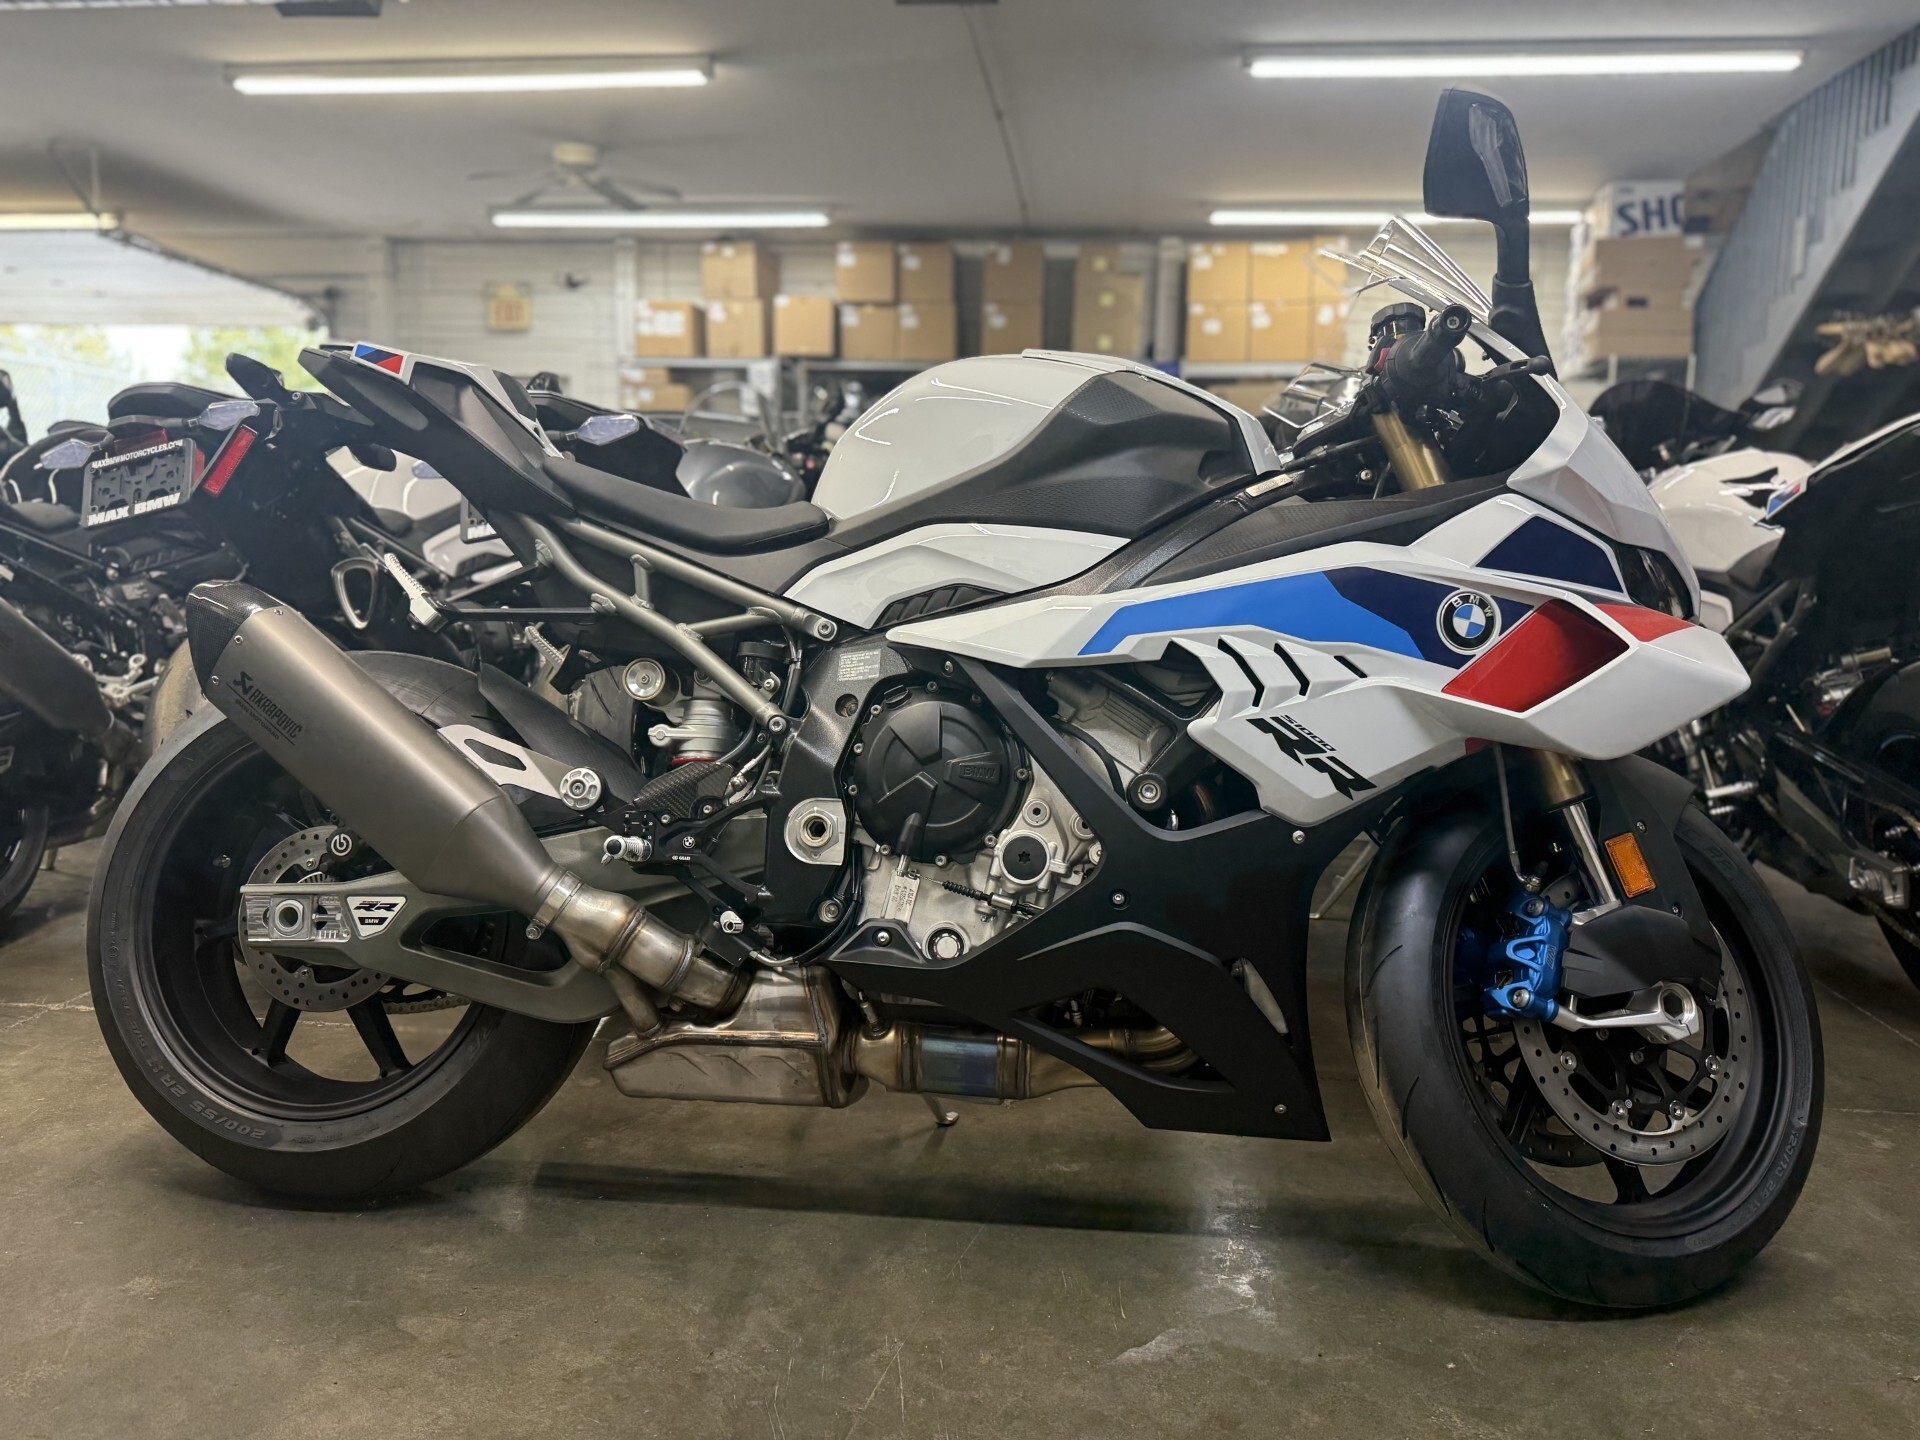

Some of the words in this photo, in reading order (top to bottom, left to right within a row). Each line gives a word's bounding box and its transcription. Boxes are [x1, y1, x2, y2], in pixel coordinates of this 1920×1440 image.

[91, 439, 183, 469] MAXBMWMOTORCYCLES.COM
[87, 505, 130, 527] MAX
[134, 492, 181, 515] BMW
[1451, 594, 1494, 618] BMW
[962, 766, 996, 779] BMW
[1246, 716, 1378, 801] RR
[189, 1100, 267, 1140] 200/55
